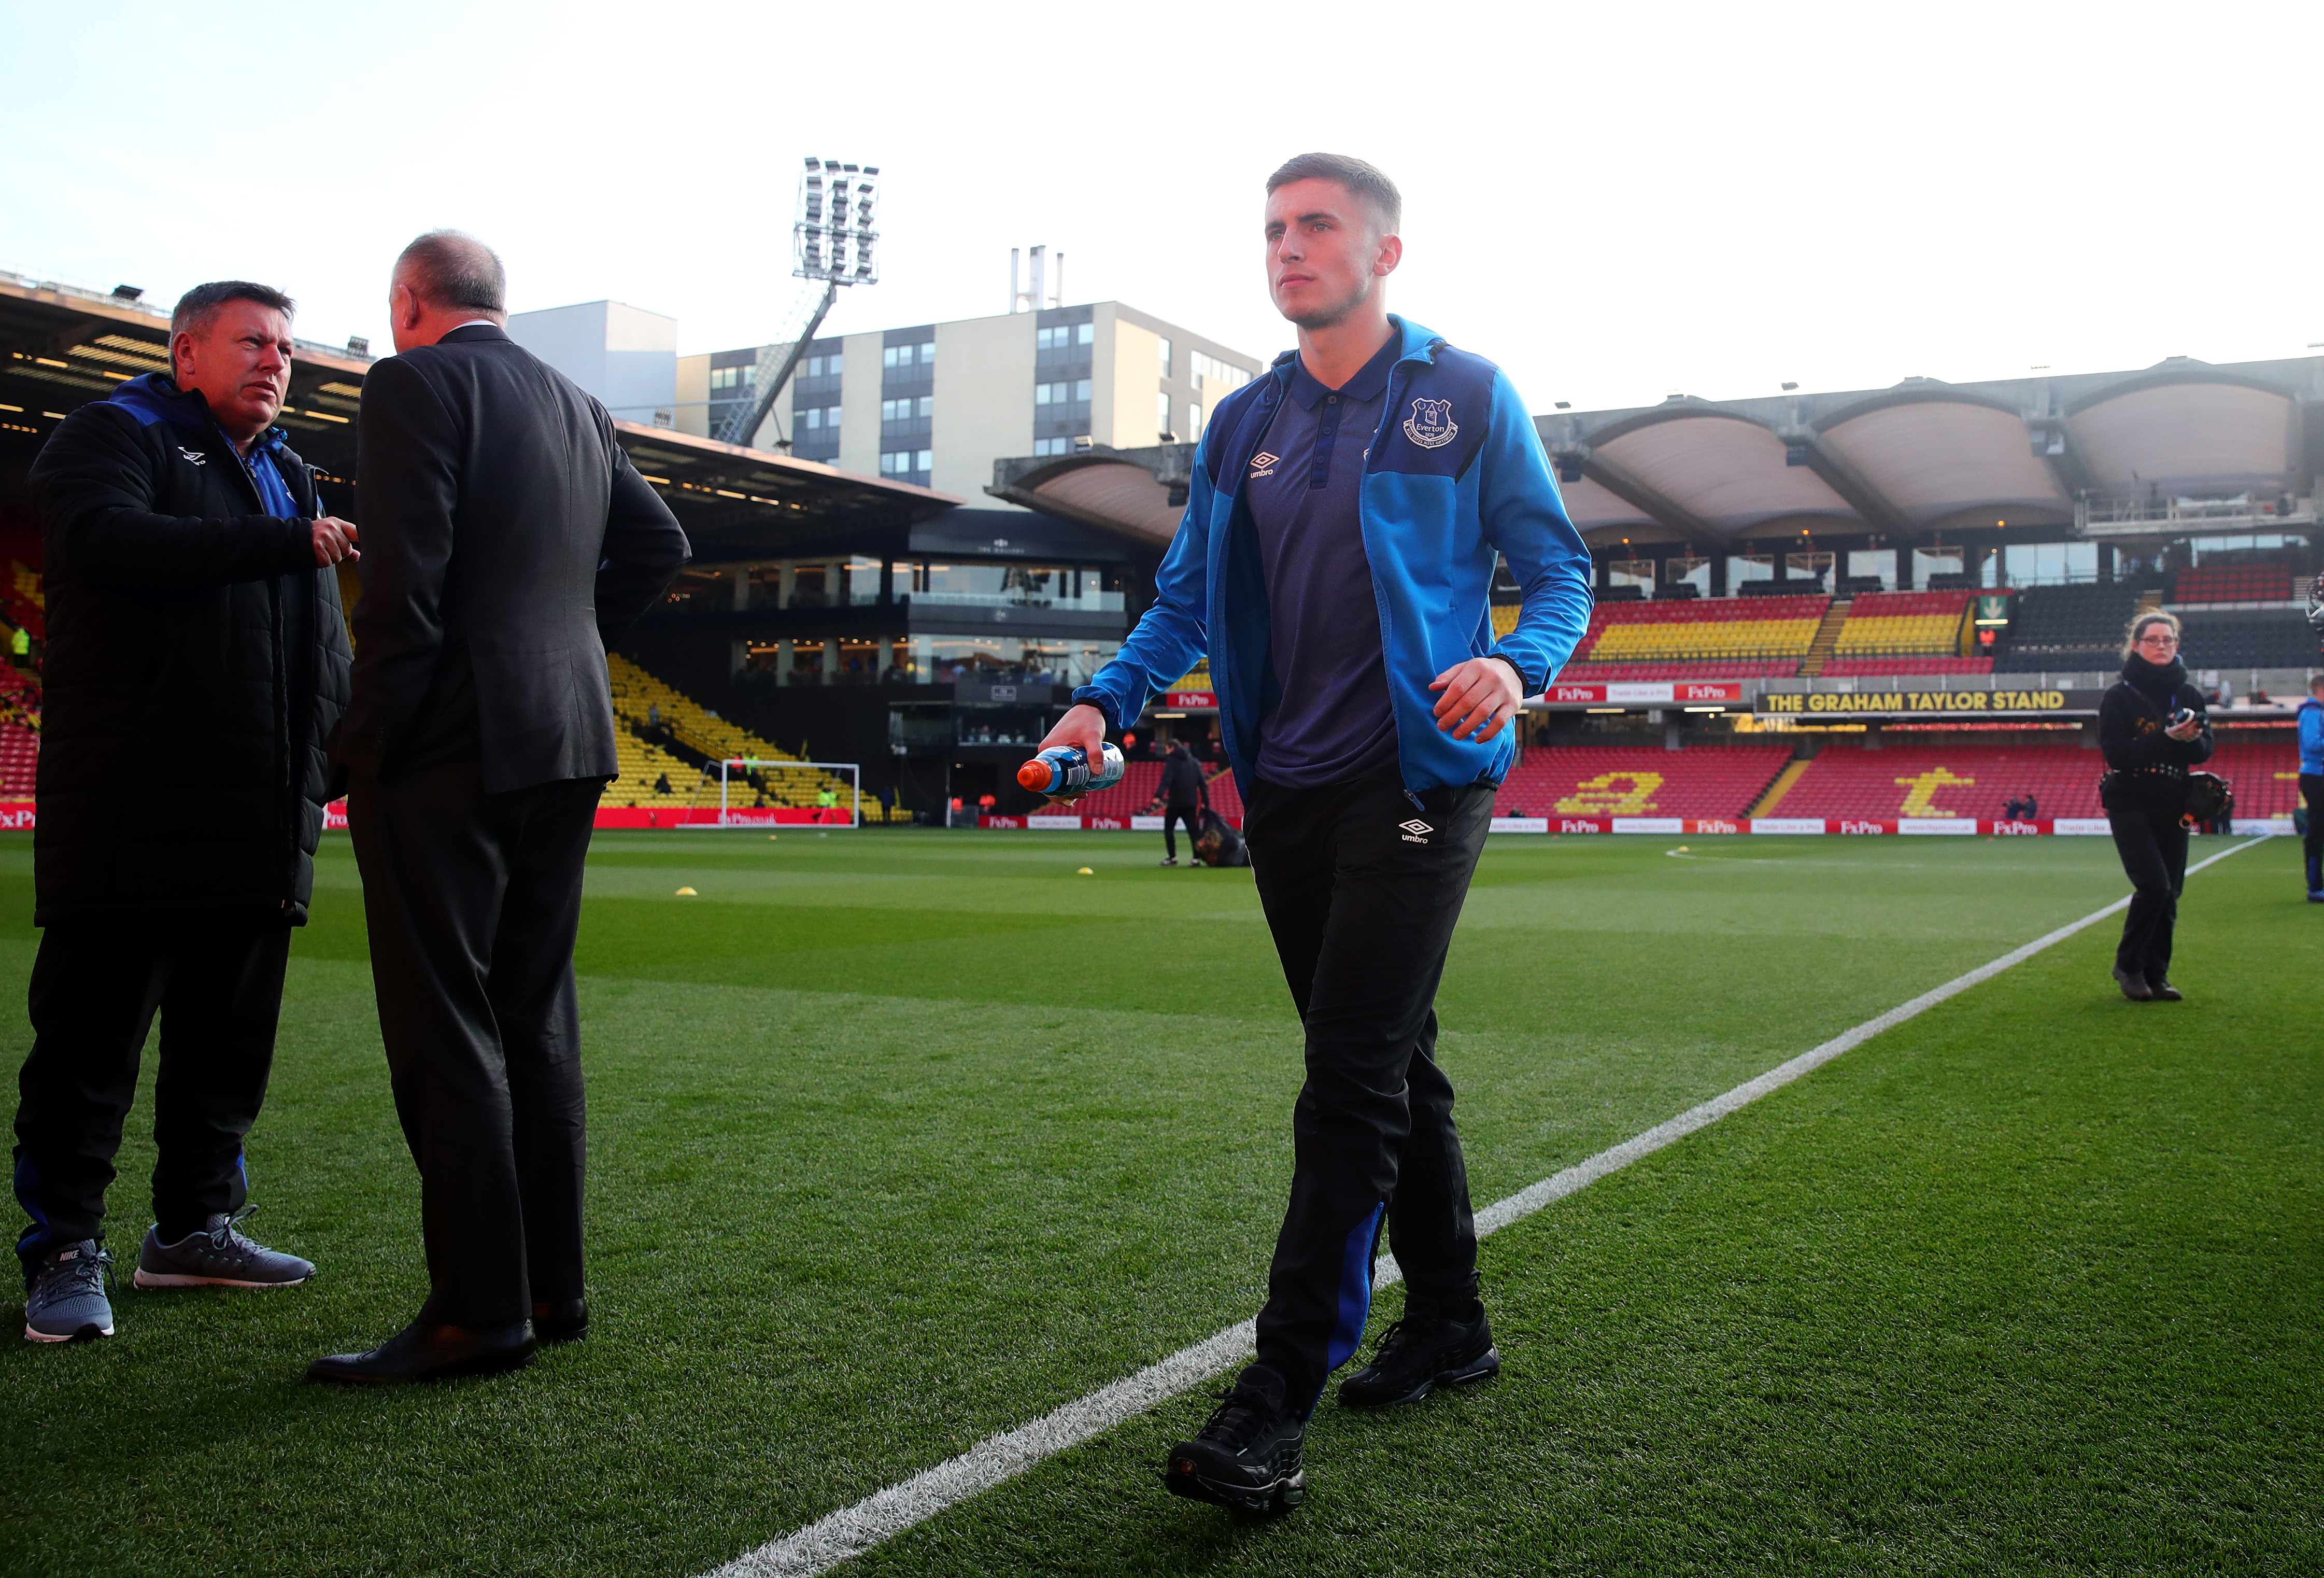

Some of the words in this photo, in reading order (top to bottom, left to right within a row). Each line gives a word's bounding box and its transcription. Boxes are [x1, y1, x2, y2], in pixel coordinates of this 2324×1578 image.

[1416, 423, 1444, 432] Everton
[1411, 435, 1423, 444] SATIS
[1435, 431, 1454, 445] OPTIMUM
[1250, 469, 1274, 478] umbro
[1557, 687, 1594, 700] FxPro
[1688, 685, 1726, 698] FxPro
[1178, 694, 1209, 706] FxPro
[1767, 694, 1804, 712] THE
[1808, 693, 1903, 711] GRAHAM
[1907, 692, 1988, 710] TAYLOR
[1992, 691, 2065, 710] STAND
[989, 816, 1018, 828] FxPro
[1092, 817, 1122, 829] FxPro
[1561, 820, 1599, 833] FxPro
[1697, 820, 1737, 834] FxPro
[1840, 820, 1883, 835] FxPro
[1993, 821, 2038, 835] FxPro
[1401, 834, 1428, 844] umbro
[60, 1249, 79, 1261] NIKE
